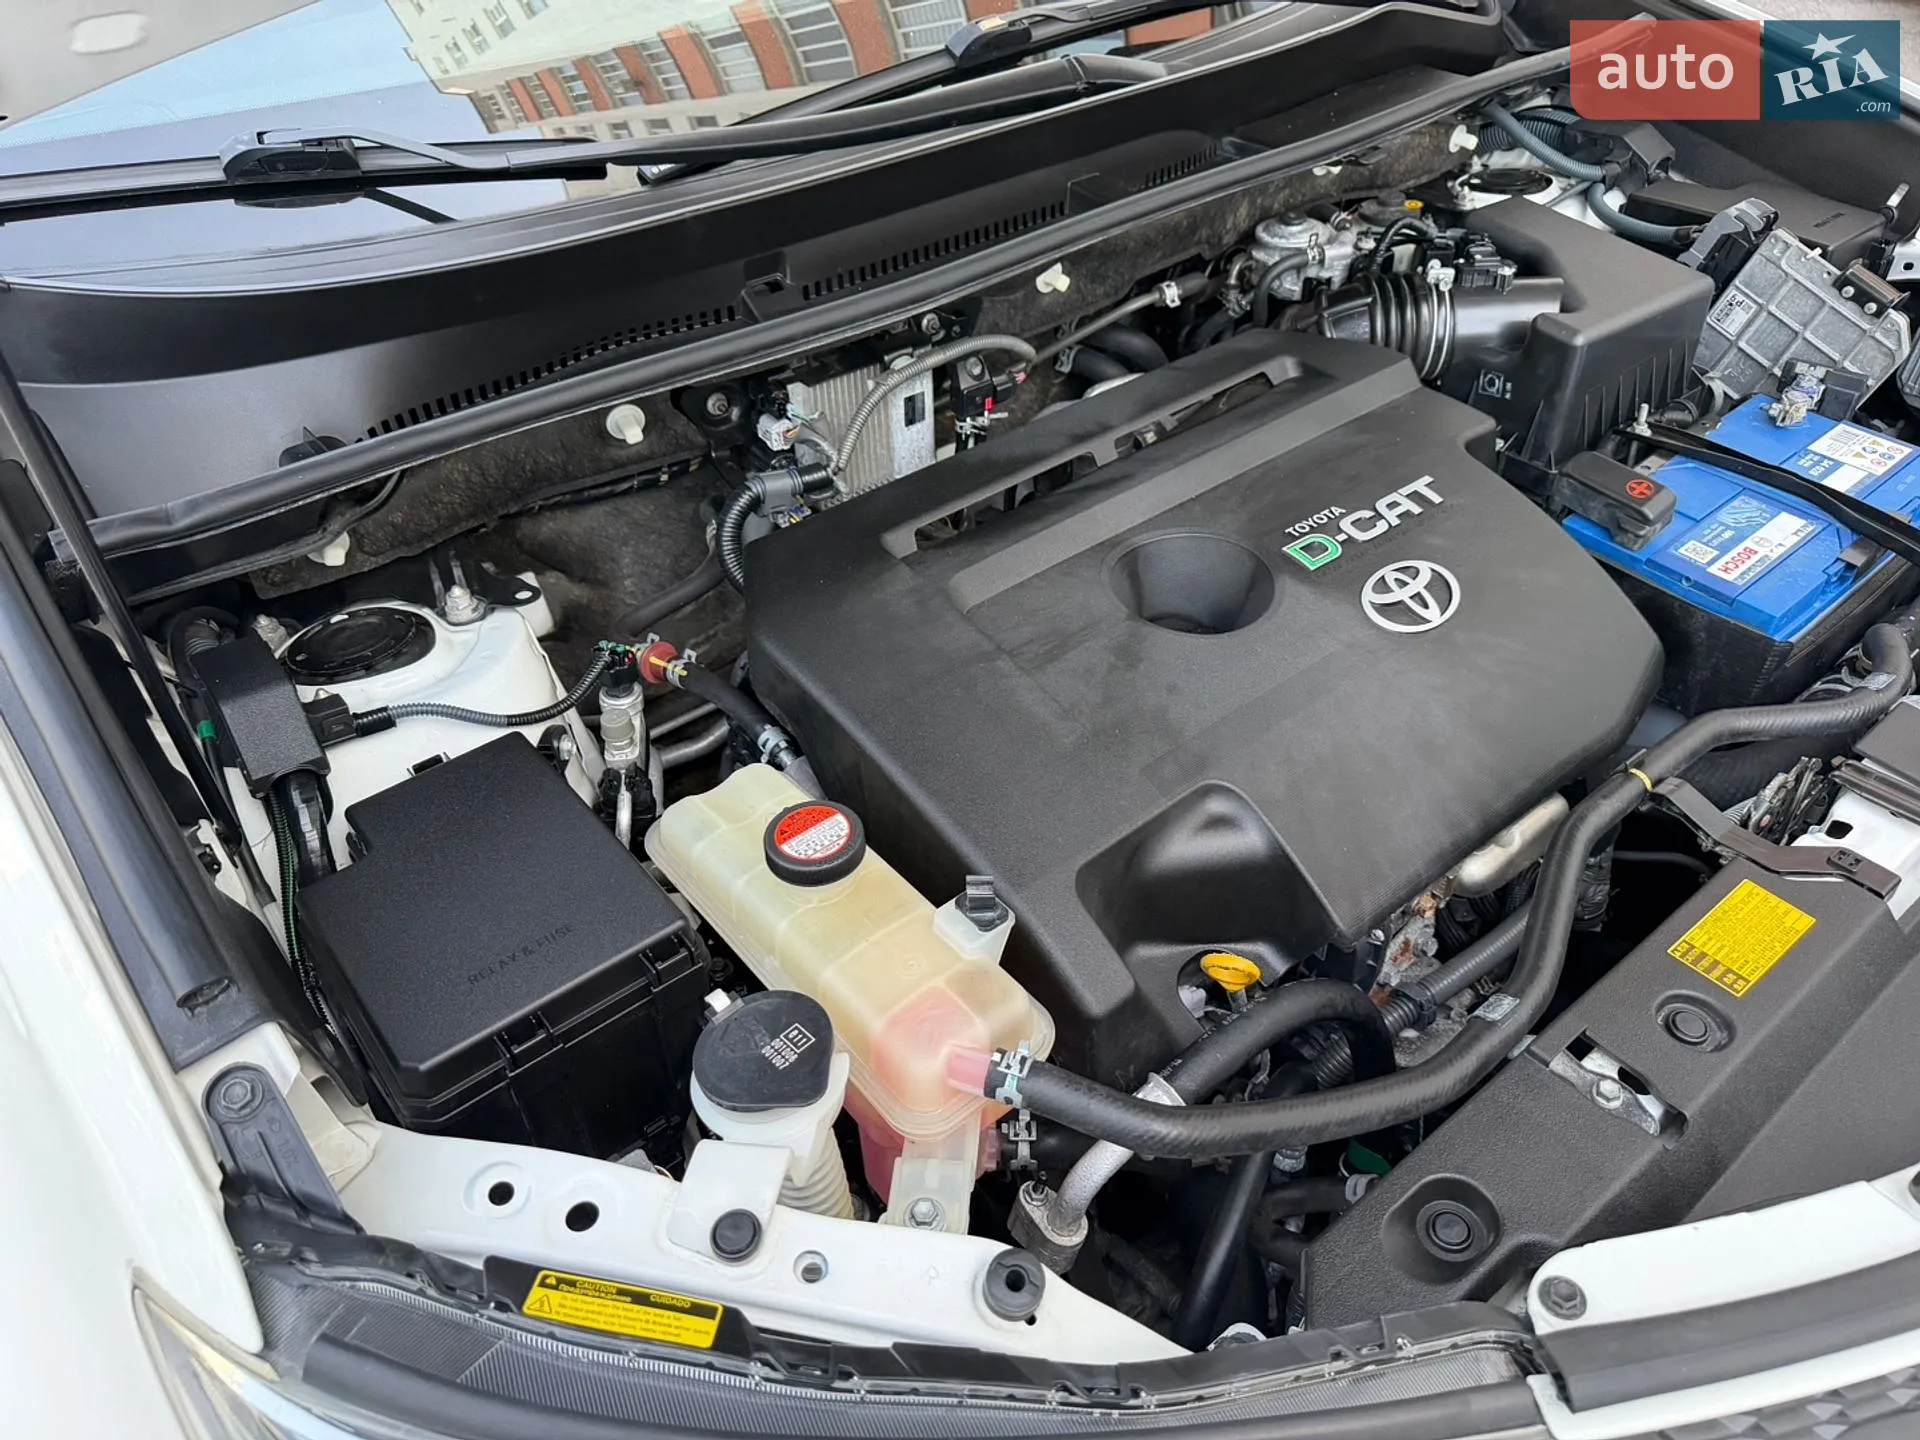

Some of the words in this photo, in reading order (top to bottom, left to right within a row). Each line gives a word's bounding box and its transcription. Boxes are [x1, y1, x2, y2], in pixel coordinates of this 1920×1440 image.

[1281, 475, 1445, 571] D-CAT
[1284, 506, 1347, 538] TOYOTA
[1717, 546, 1759, 575] BOSCH
[467, 951, 517, 985] RELAY
[575, 1279, 618, 1295] CAUTION
[650, 1294, 691, 1309] CUIDADO
